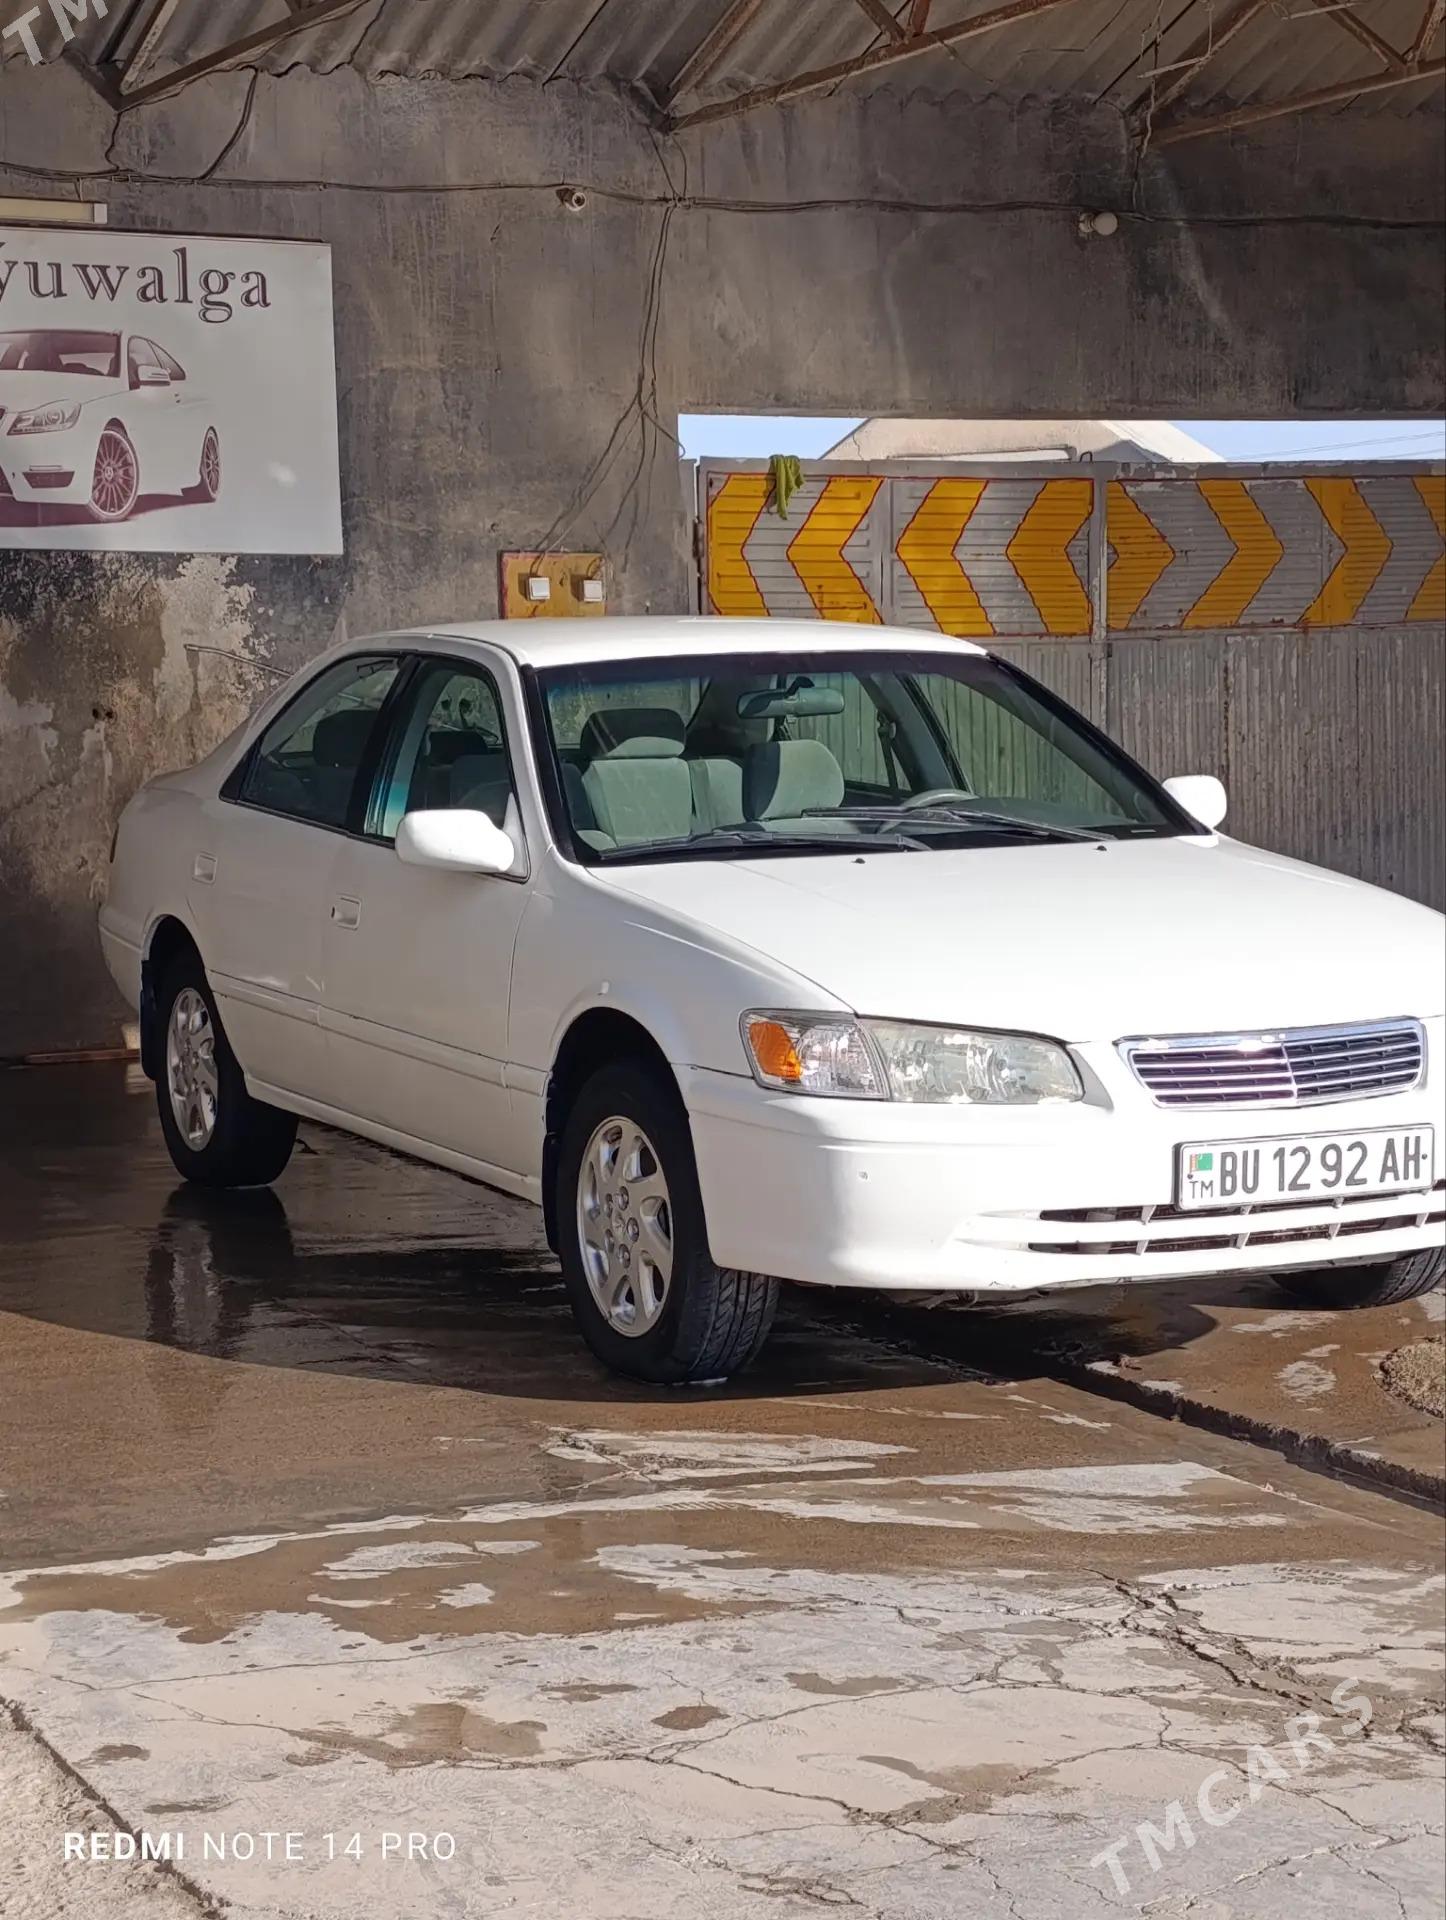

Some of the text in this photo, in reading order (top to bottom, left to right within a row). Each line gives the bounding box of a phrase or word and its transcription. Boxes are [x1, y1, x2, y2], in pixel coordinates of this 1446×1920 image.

[1219, 1148, 1260, 1197] BU
[1379, 1135, 1421, 1184] AH
[1189, 1179, 1214, 1200] TM
